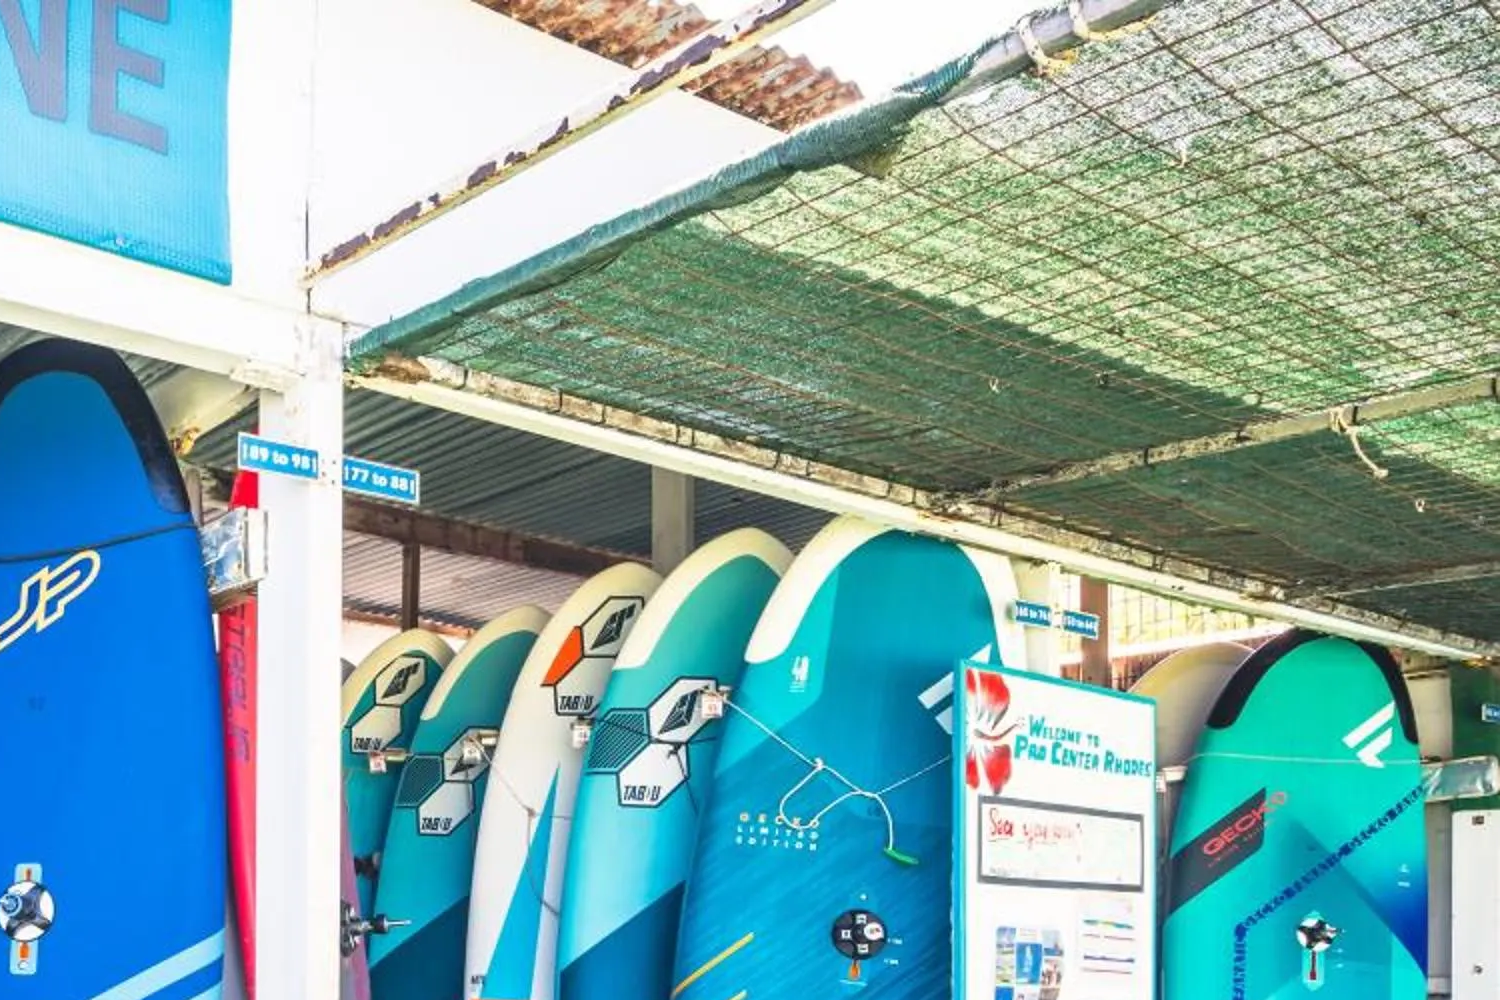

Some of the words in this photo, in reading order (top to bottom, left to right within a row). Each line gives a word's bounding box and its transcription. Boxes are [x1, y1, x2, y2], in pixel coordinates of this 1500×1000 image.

[272, 449, 288, 466] to
[351, 466, 369, 482] 77
[372, 472, 388, 488] to
[1051, 742, 1099, 771] CENTER
[1103, 750, 1153, 778] RHODES
[1203, 790, 1288, 856] GECKO
